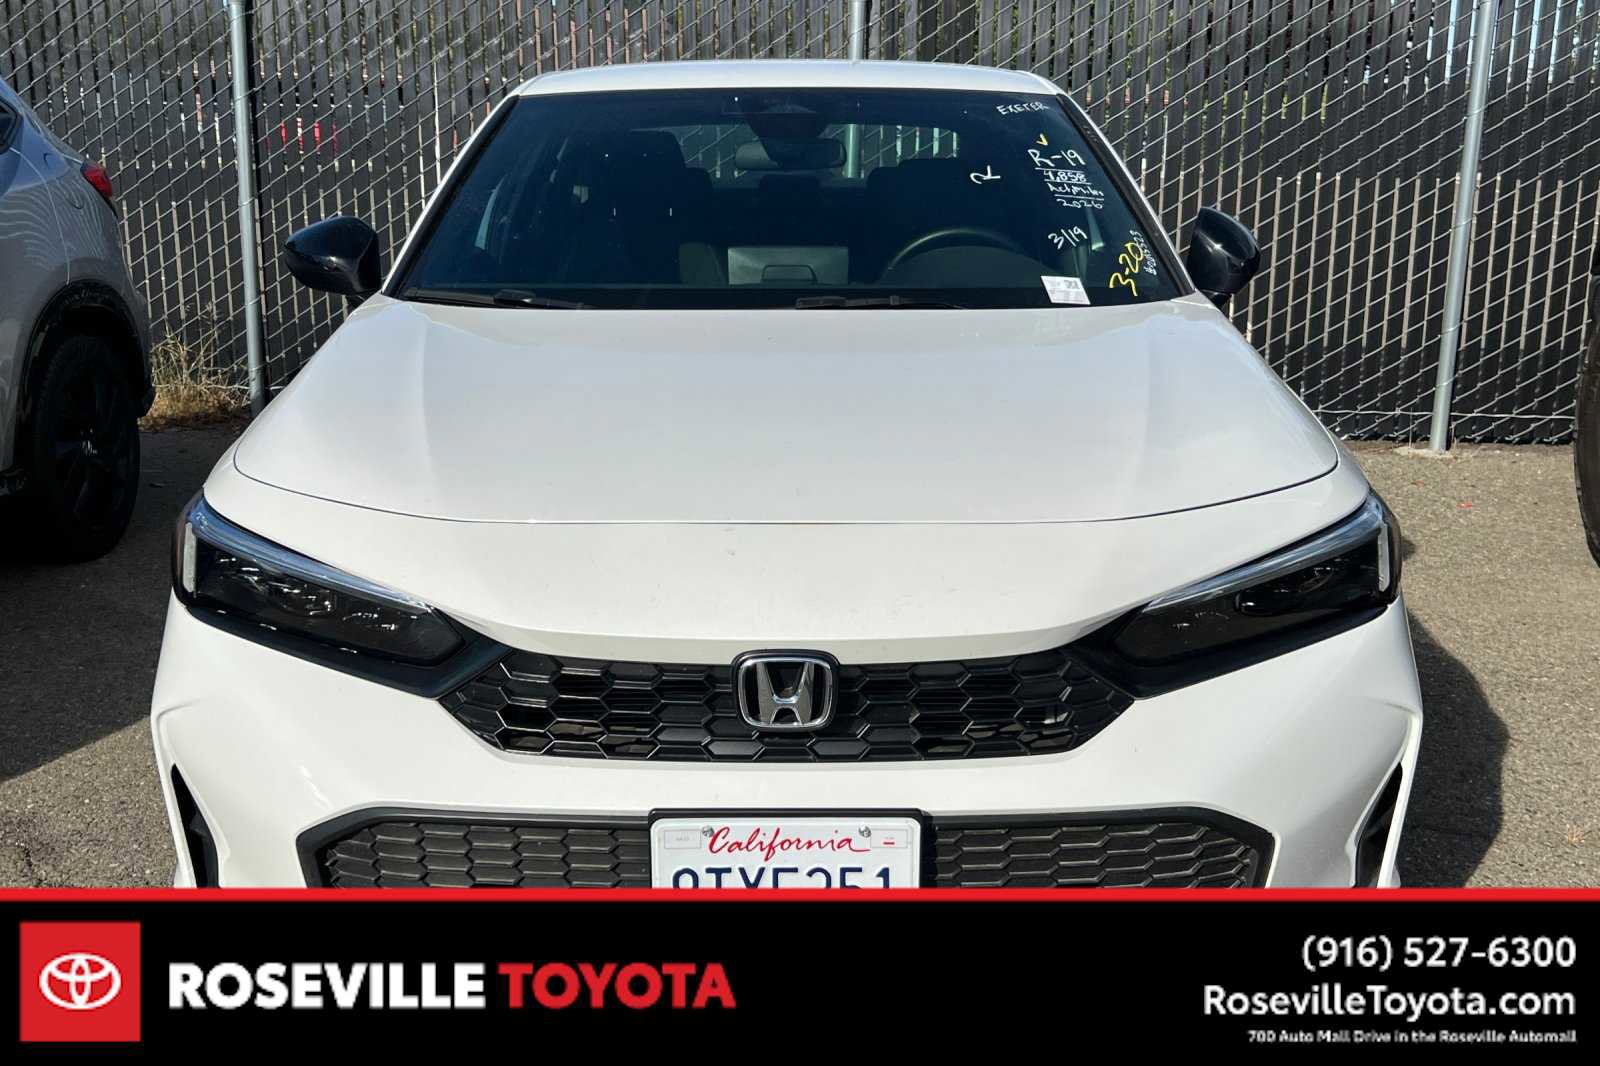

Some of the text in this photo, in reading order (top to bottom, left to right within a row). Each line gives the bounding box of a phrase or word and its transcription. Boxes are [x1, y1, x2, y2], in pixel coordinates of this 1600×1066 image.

[996, 101, 1051, 115] EXETER
[1056, 198, 1103, 210] 2026
[1047, 226, 1088, 251] 3/19
[1108, 242, 1144, 297] 3-20
[707, 826, 872, 863] California
